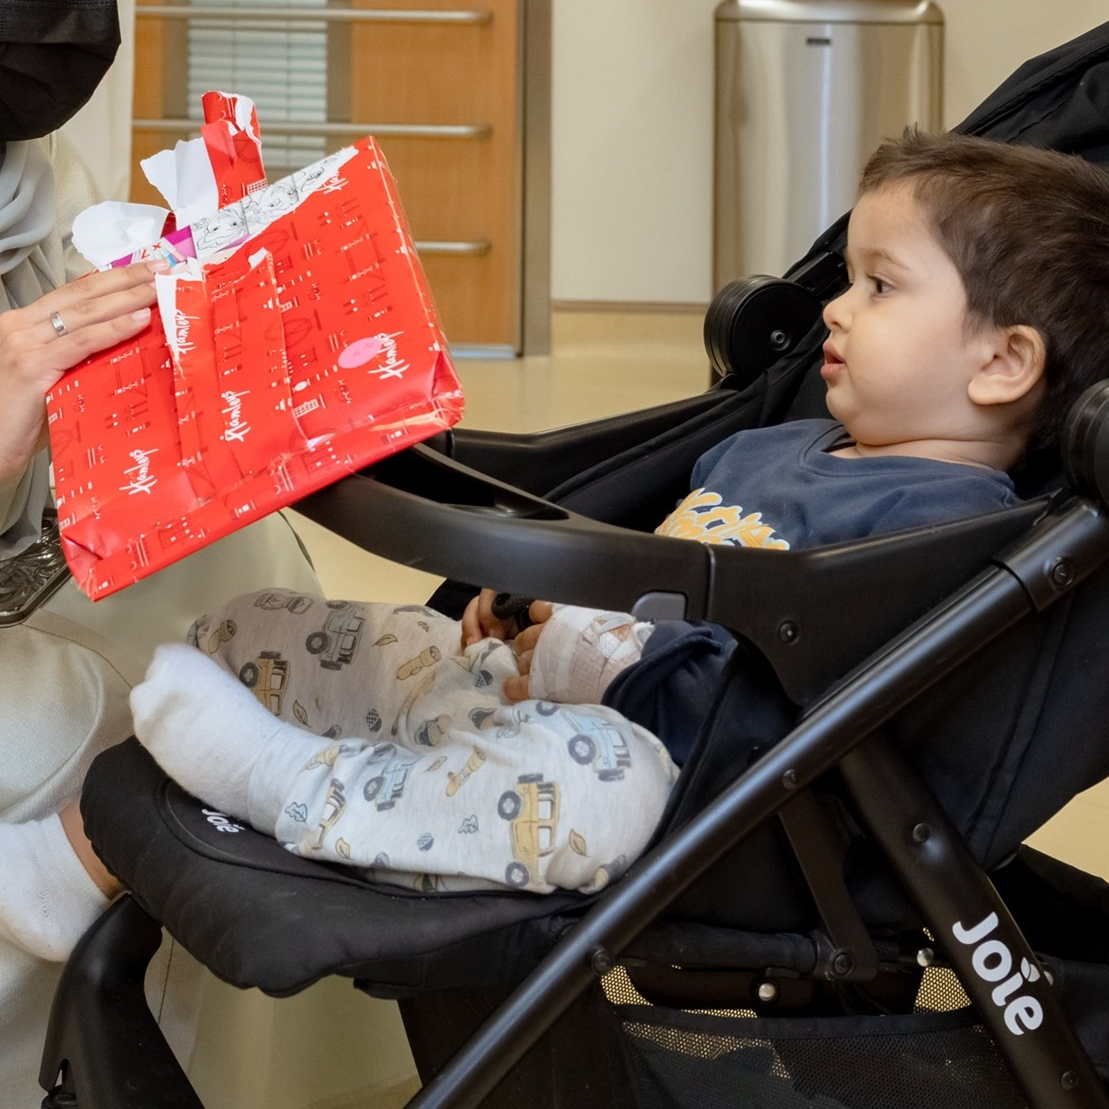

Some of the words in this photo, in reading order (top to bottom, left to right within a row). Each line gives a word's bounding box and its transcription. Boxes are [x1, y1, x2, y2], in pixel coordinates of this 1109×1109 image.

[219, 389, 251, 443] Hamleys
[118, 448, 159, 496] Hamleys
[952, 911, 1043, 1036] Joie
